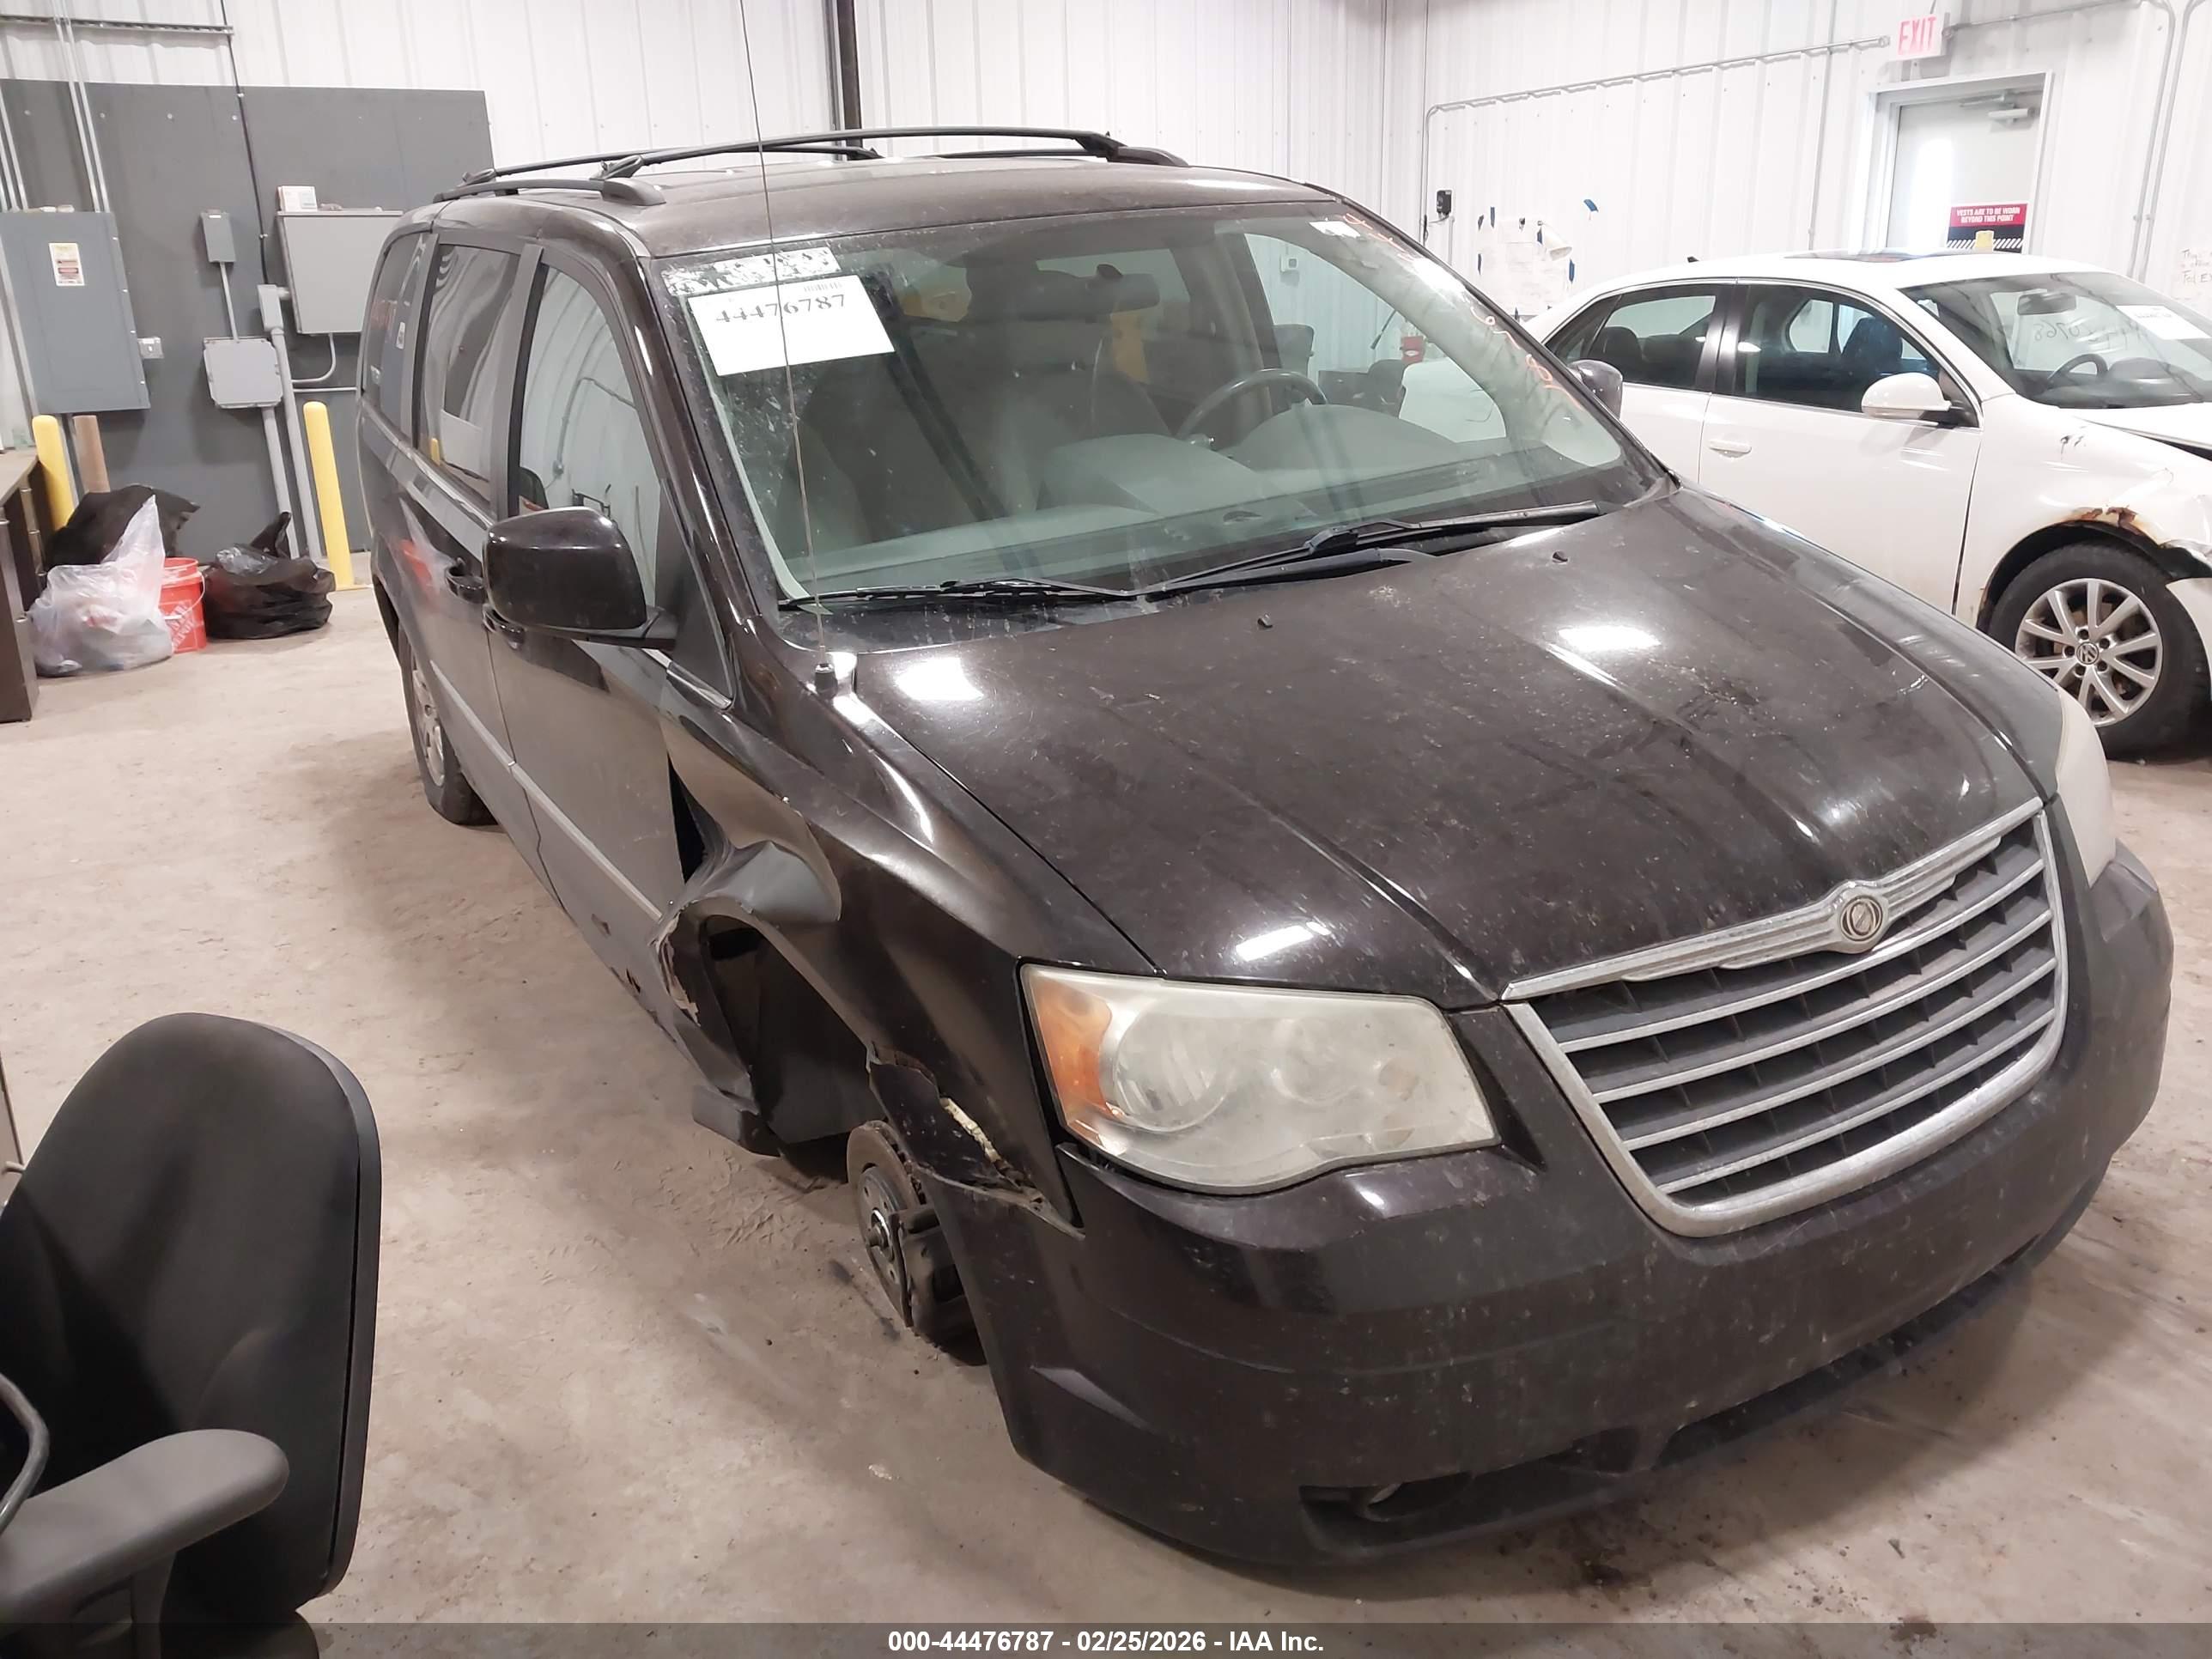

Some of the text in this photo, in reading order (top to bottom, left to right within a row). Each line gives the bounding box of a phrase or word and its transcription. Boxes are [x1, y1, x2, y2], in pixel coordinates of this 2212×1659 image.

[1898, 15, 1937, 56] EXIT
[1997, 214, 2015, 222] POINT
[2003, 206, 2021, 215] WORN
[715, 293, 846, 323] 44476787
